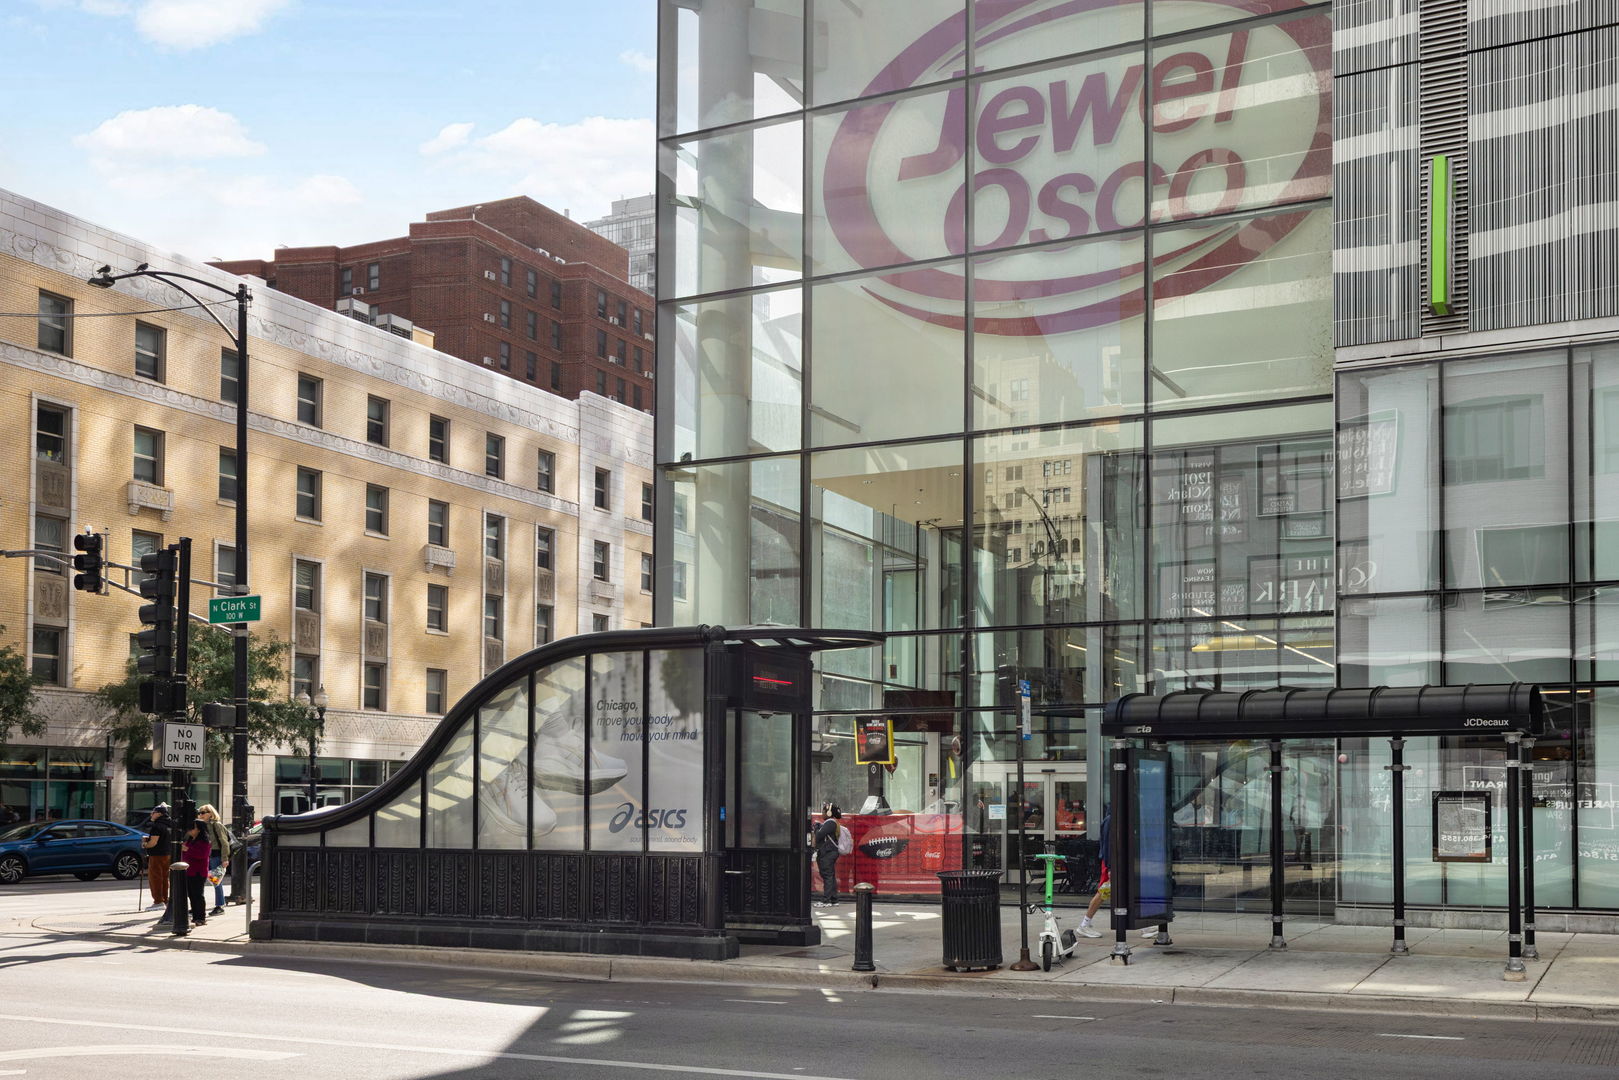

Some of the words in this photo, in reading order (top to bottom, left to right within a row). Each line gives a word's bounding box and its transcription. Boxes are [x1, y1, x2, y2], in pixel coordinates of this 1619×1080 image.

[897, 28, 1251, 182] Jewel
[220, 601, 246, 611] Clark
[249, 602, 256, 610] St
[596, 699, 638, 713] Chicago,
[596, 717, 621, 726] move
[623, 716, 643, 728] you
[647, 713, 674, 726] body,
[1463, 718, 1509, 727] JCDecaux
[177, 729, 193, 738] NO
[1136, 725, 1152, 733] cta
[648, 731, 670, 743] your
[672, 729, 698, 740] mind
[173, 741, 197, 751] TURN
[167, 753, 180, 762] ON
[184, 754, 201, 764] RED
